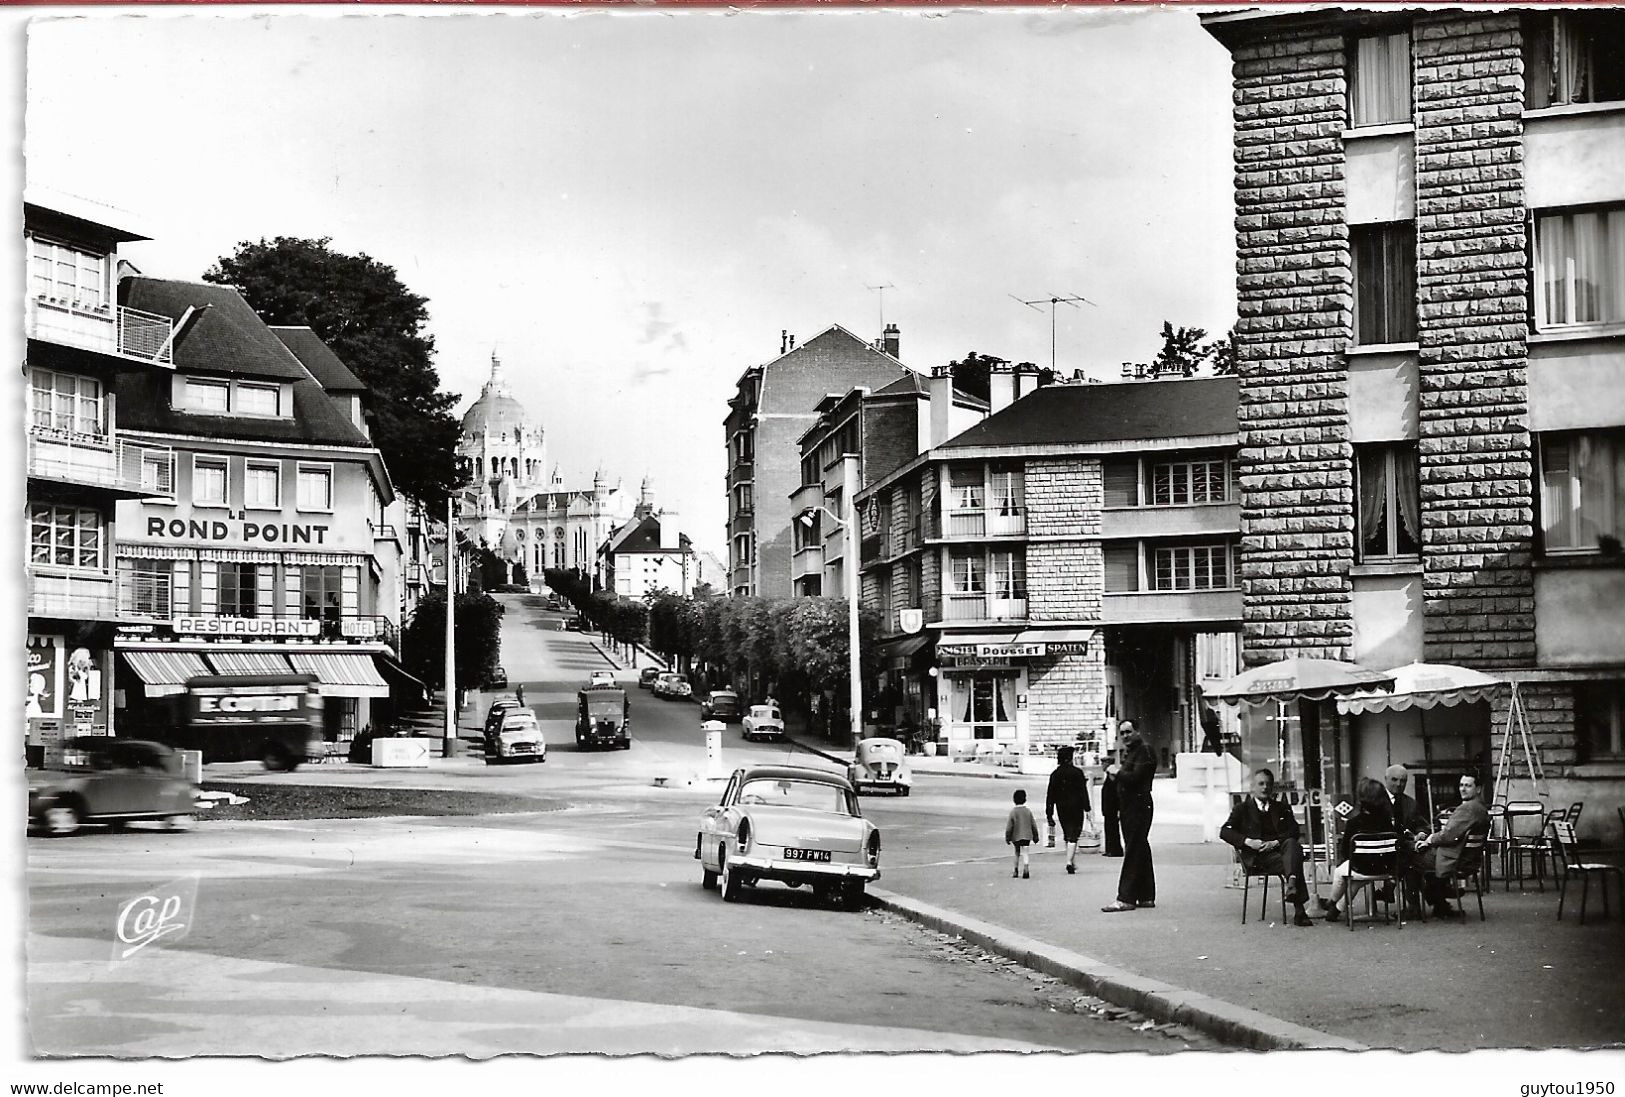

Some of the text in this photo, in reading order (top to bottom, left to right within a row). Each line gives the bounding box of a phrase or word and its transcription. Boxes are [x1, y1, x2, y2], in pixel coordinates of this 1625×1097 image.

[228, 510, 246, 521] LE
[147, 516, 329, 545] ROND POINT
[180, 618, 314, 634] RESTAURANT
[343, 622, 374, 635] HOTEL
[1047, 643, 1087, 653] SPATEN
[786, 848, 804, 859] 997
